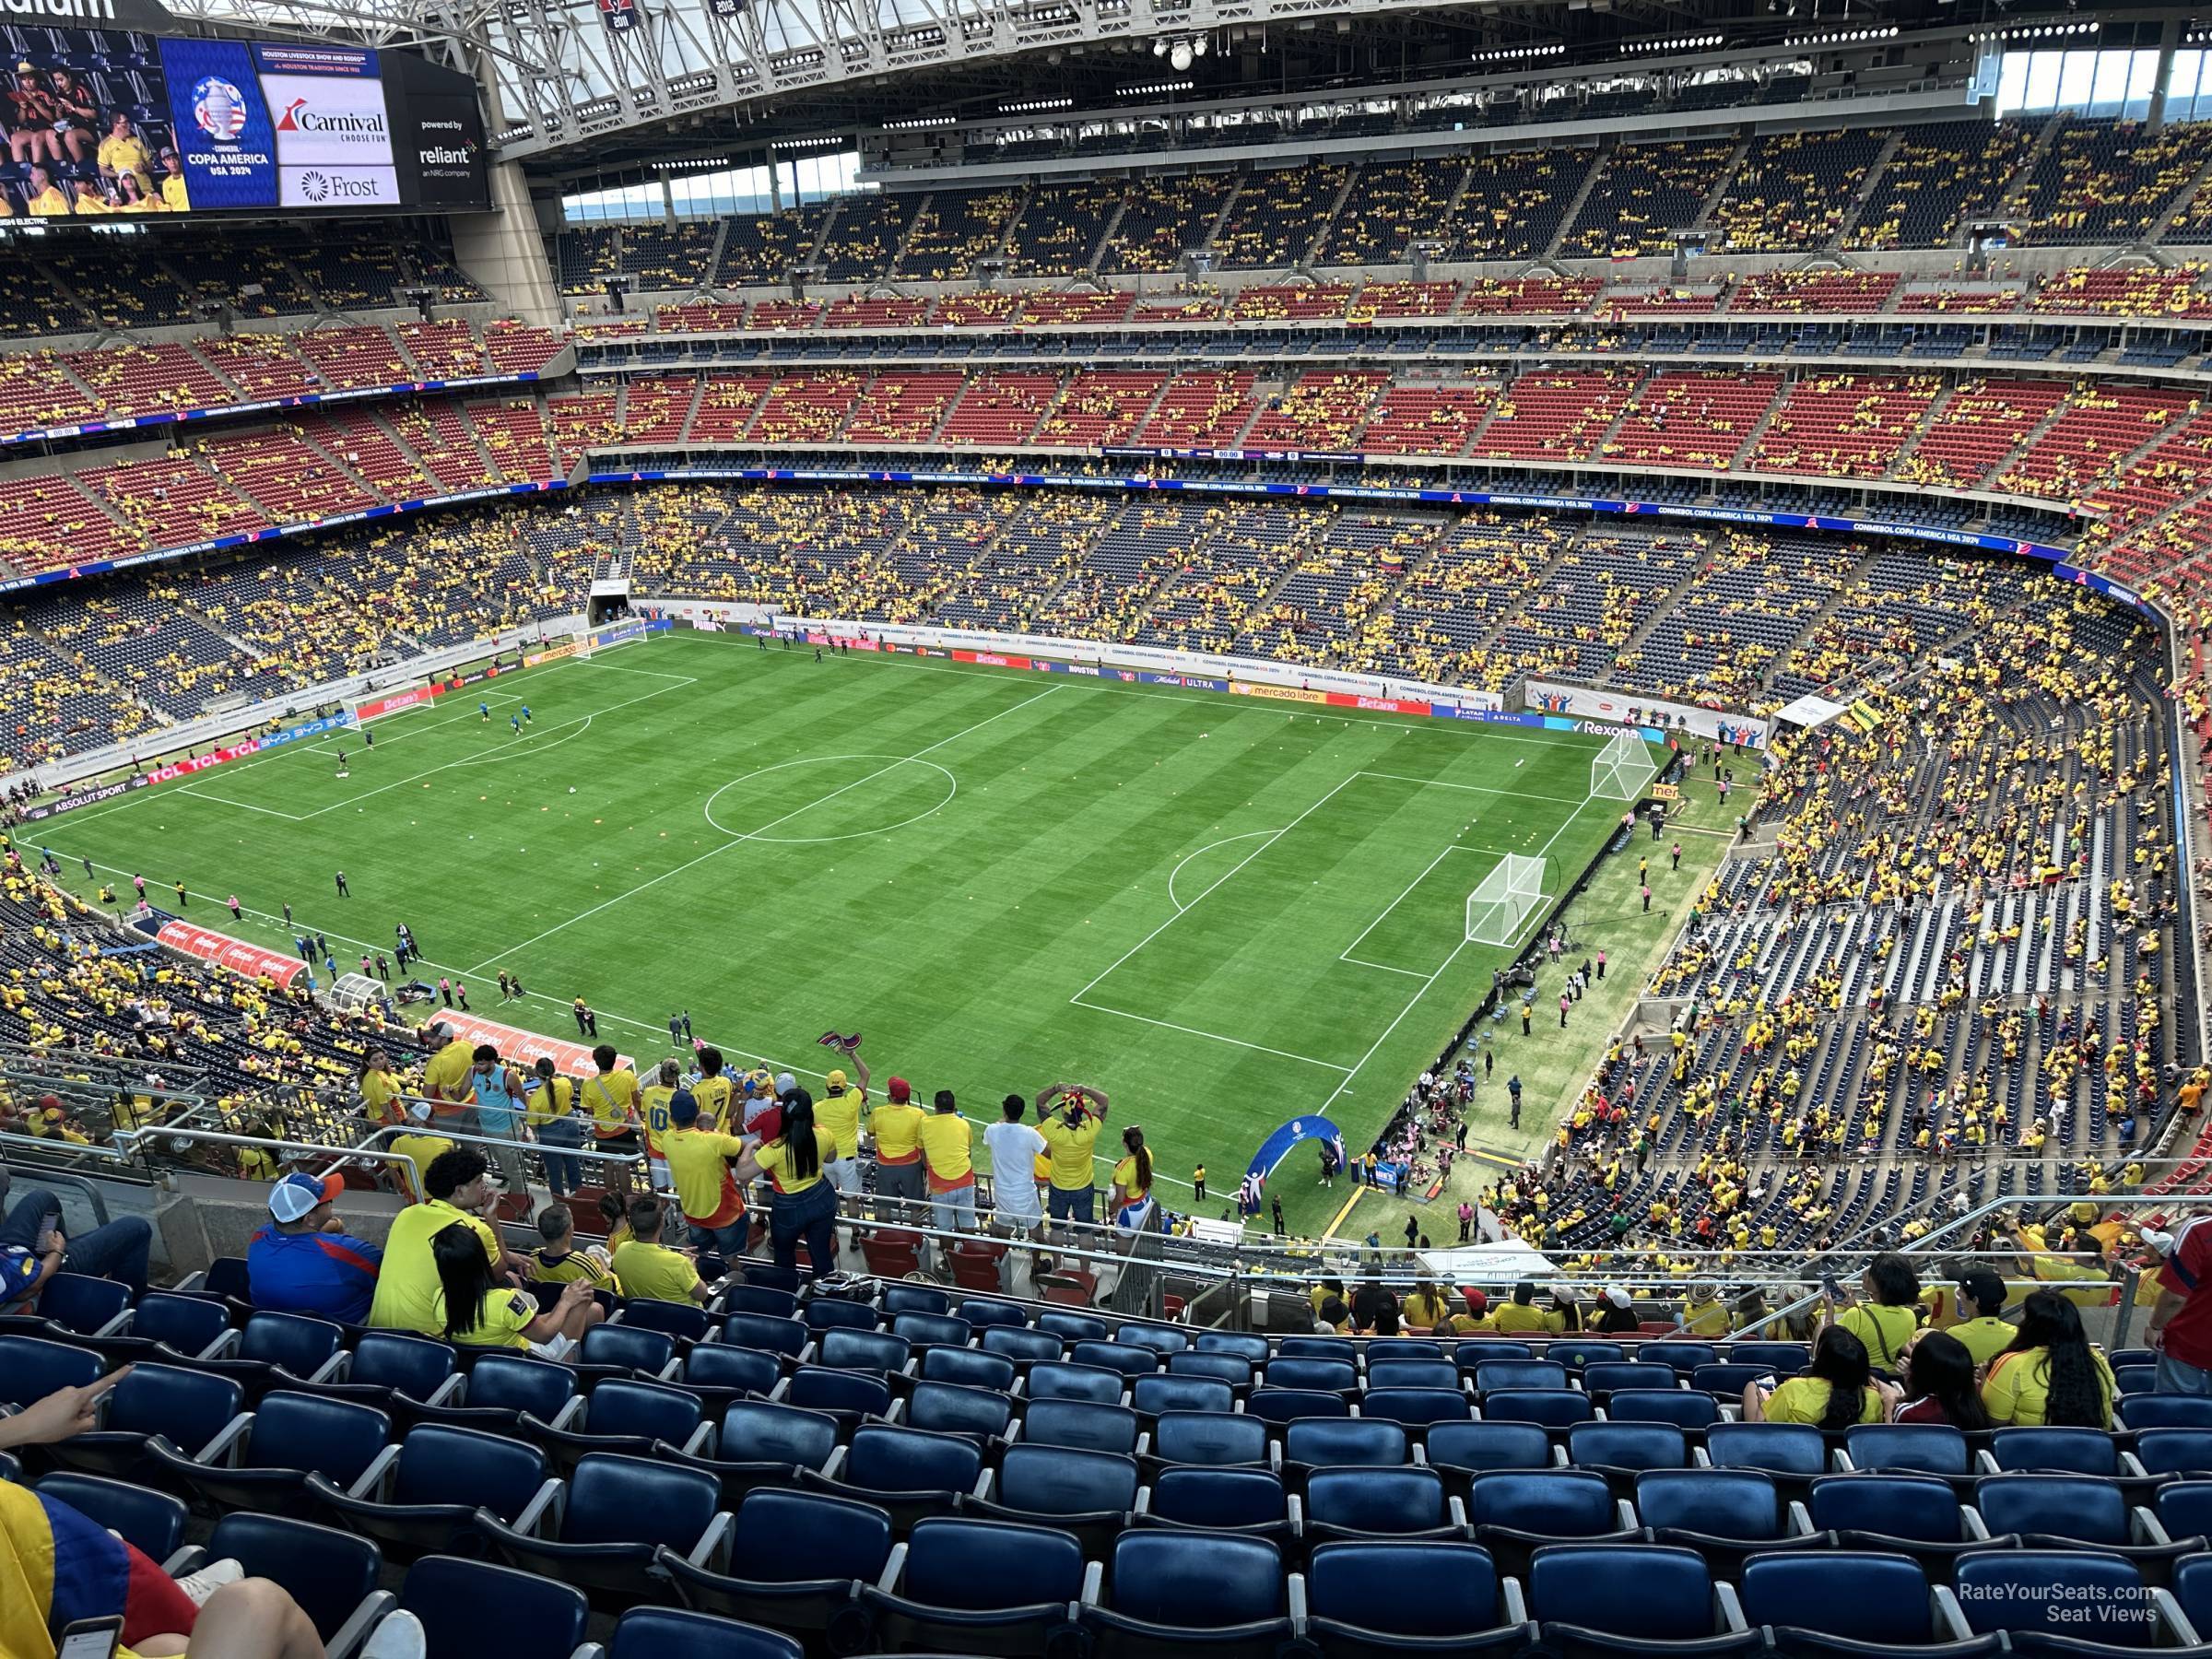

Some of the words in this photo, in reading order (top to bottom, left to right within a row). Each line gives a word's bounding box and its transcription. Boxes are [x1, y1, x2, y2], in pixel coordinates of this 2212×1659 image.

[716, 0, 735, 13] 2012
[614, 17, 629, 28] 2011
[289, 52, 315, 60] LIVESTOCK
[301, 112, 383, 131] Carnival
[422, 121, 453, 130] powered
[453, 121, 462, 131] by
[188, 154, 218, 164] COPA
[220, 154, 268, 164] AMERICA
[420, 147, 469, 164] reliant
[210, 166, 229, 175] USA
[229, 166, 252, 175] 2024
[330, 176, 380, 196] Frost
[1489, 497, 1522, 505] CONMEBOL
[1523, 498, 1537, 506] COPA
[1539, 499, 1564, 507] AMERICA
[1659, 507, 1694, 517] CONMEBOL
[1695, 509, 1712, 518] COPA
[1713, 511, 1742, 520] AMERICA
[1743, 512, 1755, 522] USA
[1853, 523, 1893, 535] CONMEBOL
[1895, 526, 1914, 537] COPA
[1916, 528, 1946, 540] AMERICA
[1947, 531, 1960, 542] USA
[1962, 533, 1979, 544] 2024
[693, 619, 716, 631] PUMA
[545, 645, 577, 660] mercado
[976, 653, 1006, 665] Betano
[1069, 665, 1099, 676] HOUSTON
[1186, 678, 1214, 689] ULTRA
[1254, 688, 1296, 699] mercado
[1298, 690, 1318, 700] libre
[383, 694, 419, 711] Betano
[1357, 698, 1397, 711] Betano
[1462, 709, 1484, 717] LATAM
[1584, 721, 1638, 738] Rexona
[228, 740, 259, 756] TCL
[190, 755, 222, 771] TCL
[150, 765, 184, 782] TCL
[55, 792, 97, 813] ABSOLUT
[97, 783, 126, 800] SPORT
[469, 1030, 502, 1046] Betano
[522, 1044, 557, 1059] Betano
[713, 1097, 725, 1120] 7
[649, 1106, 668, 1131] 10
